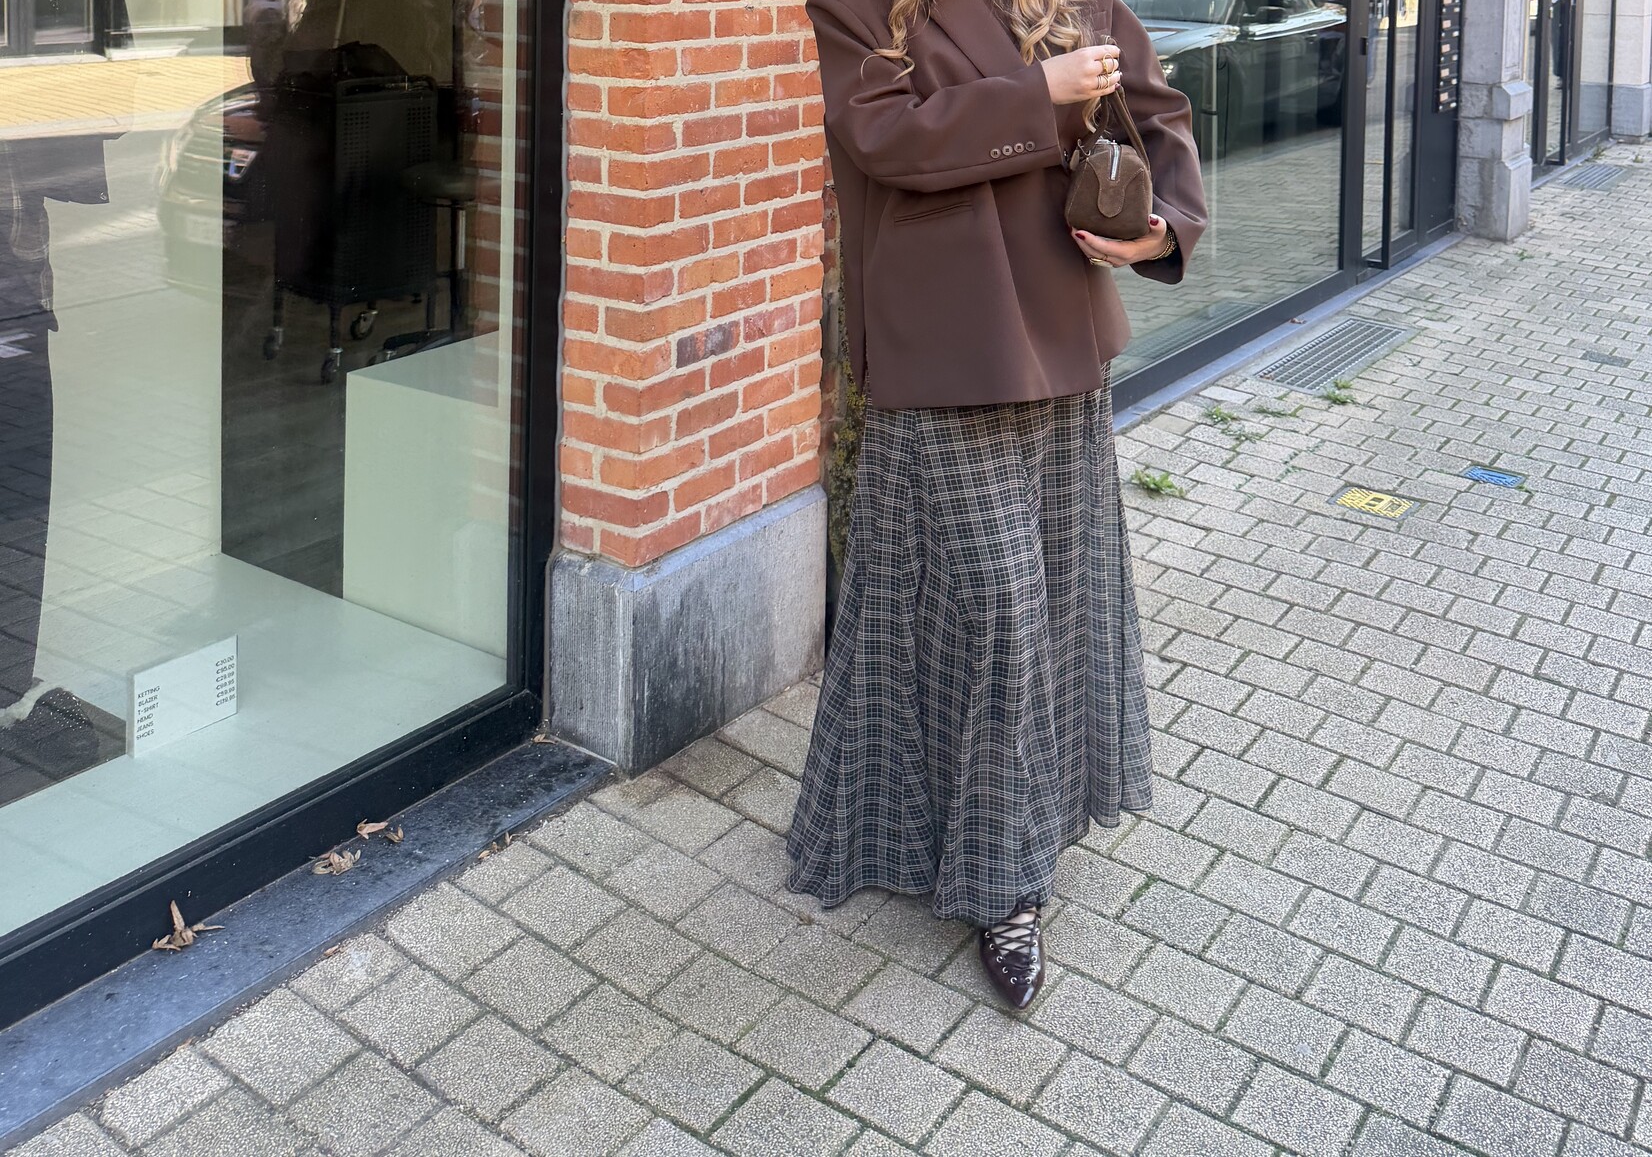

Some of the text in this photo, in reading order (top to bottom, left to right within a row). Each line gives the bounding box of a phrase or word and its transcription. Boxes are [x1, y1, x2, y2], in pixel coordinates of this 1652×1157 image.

[138, 686, 160, 698] KETTING
[138, 694, 159, 707] BLAZER
[137, 701, 159, 716] T-SHIRT
[136, 720, 155, 733] JEANS
[136, 728, 155, 741] SHOES
